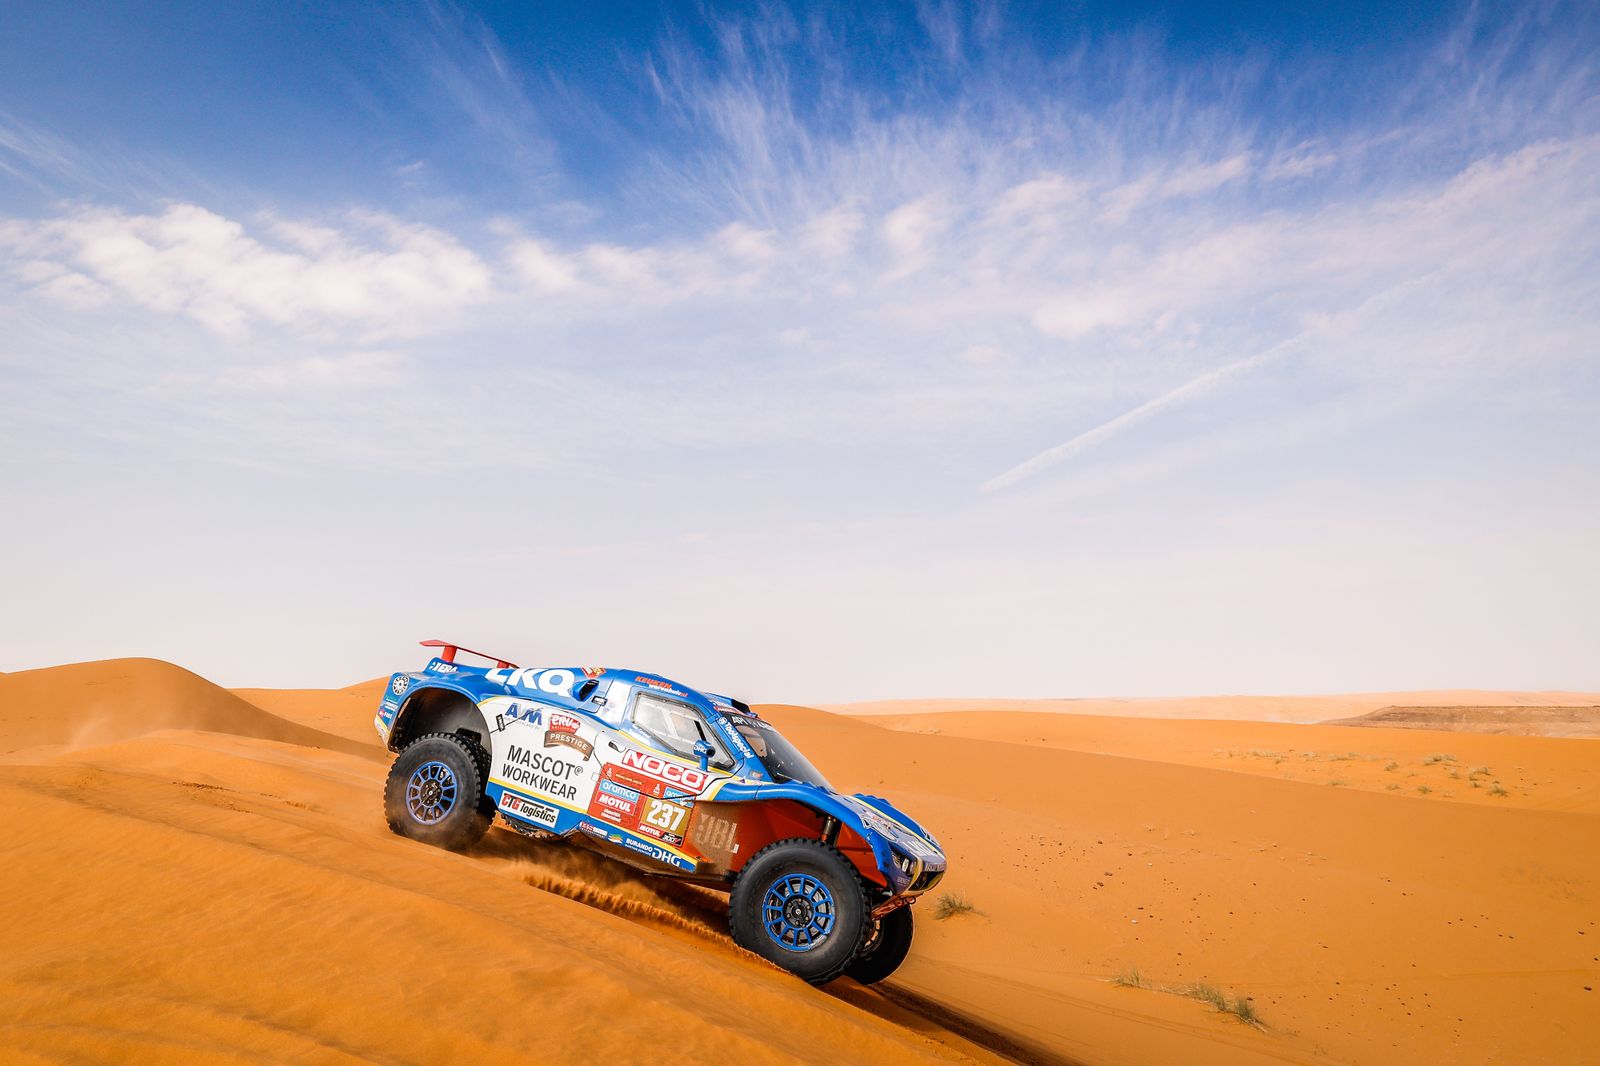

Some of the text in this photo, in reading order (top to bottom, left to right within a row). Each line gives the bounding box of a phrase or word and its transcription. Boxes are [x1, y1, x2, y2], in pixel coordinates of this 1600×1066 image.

[550, 733, 588, 750] PRESTIGE
[724, 720, 755, 759] Toolspecial
[622, 749, 705, 789] NOCO
[502, 763, 577, 801] WORKWEAR
[602, 781, 637, 799] aramco
[501, 792, 557, 823] CTG logistics
[598, 794, 631, 813] MOTUL
[646, 799, 686, 832] 237
[639, 824, 661, 838] MOTUL
[626, 837, 653, 853] BURANDO
[651, 847, 681, 868] DHG
